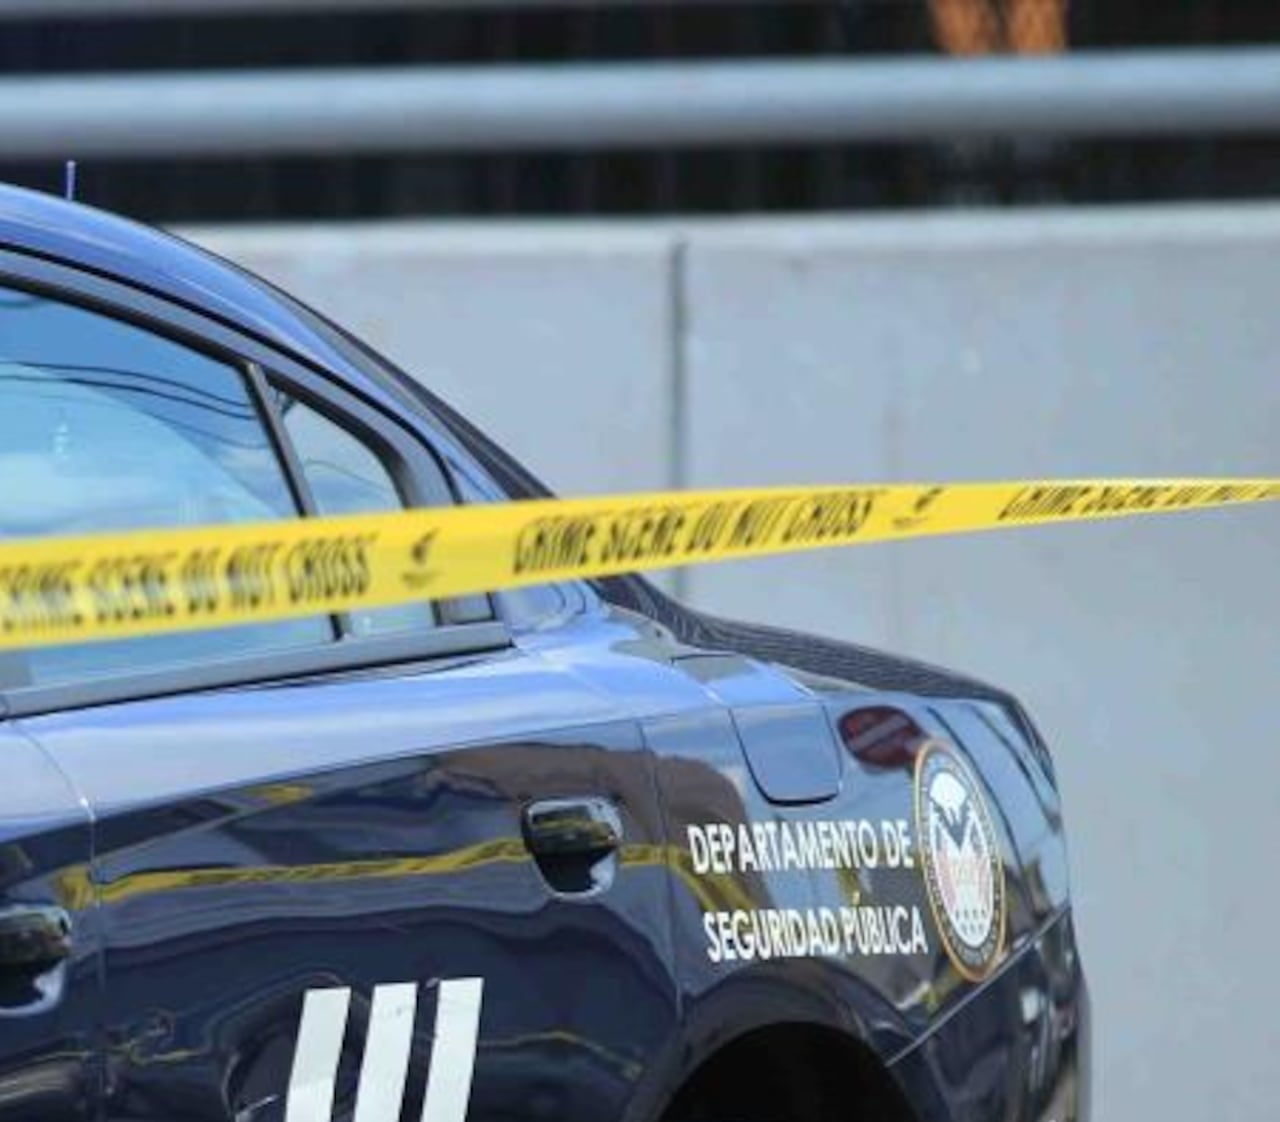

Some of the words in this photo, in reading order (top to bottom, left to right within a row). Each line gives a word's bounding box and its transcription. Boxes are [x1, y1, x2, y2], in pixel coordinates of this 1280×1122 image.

[513, 516, 596, 575] CRIME
[687, 820, 878, 875] DEPARTAMENTO
[881, 820, 915, 869] DE
[703, 908, 842, 963] SEGURIDAD
[839, 891, 929, 956] PÚBLICA
